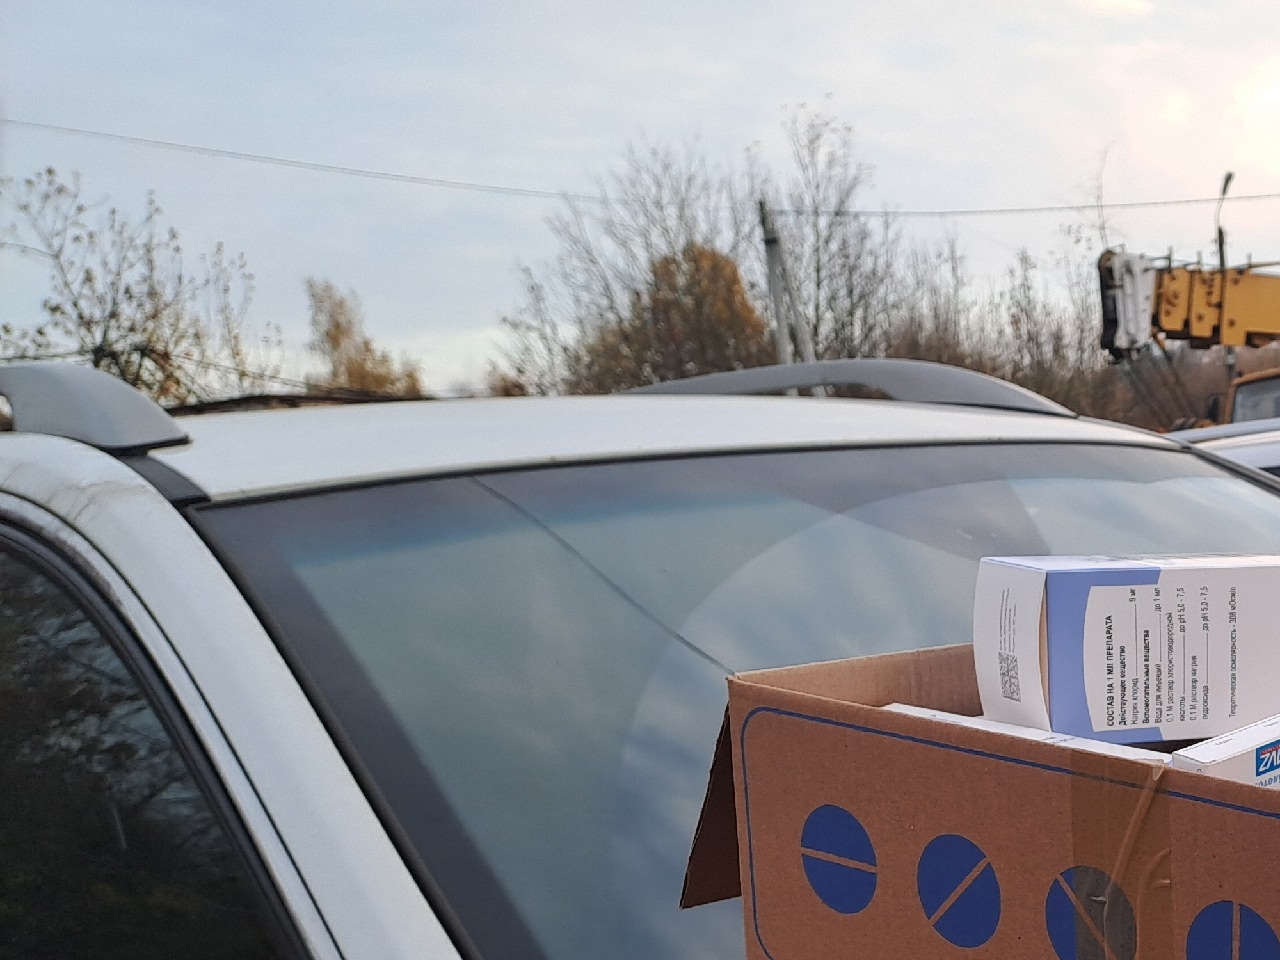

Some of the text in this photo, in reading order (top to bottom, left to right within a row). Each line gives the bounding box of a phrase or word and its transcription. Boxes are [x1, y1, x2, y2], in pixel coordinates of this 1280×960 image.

[1155, 604, 1162, 612] до
[1202, 623, 1209, 631] до
[1106, 664, 1113, 674] МЛ
[1107, 683, 1114, 693] НА
